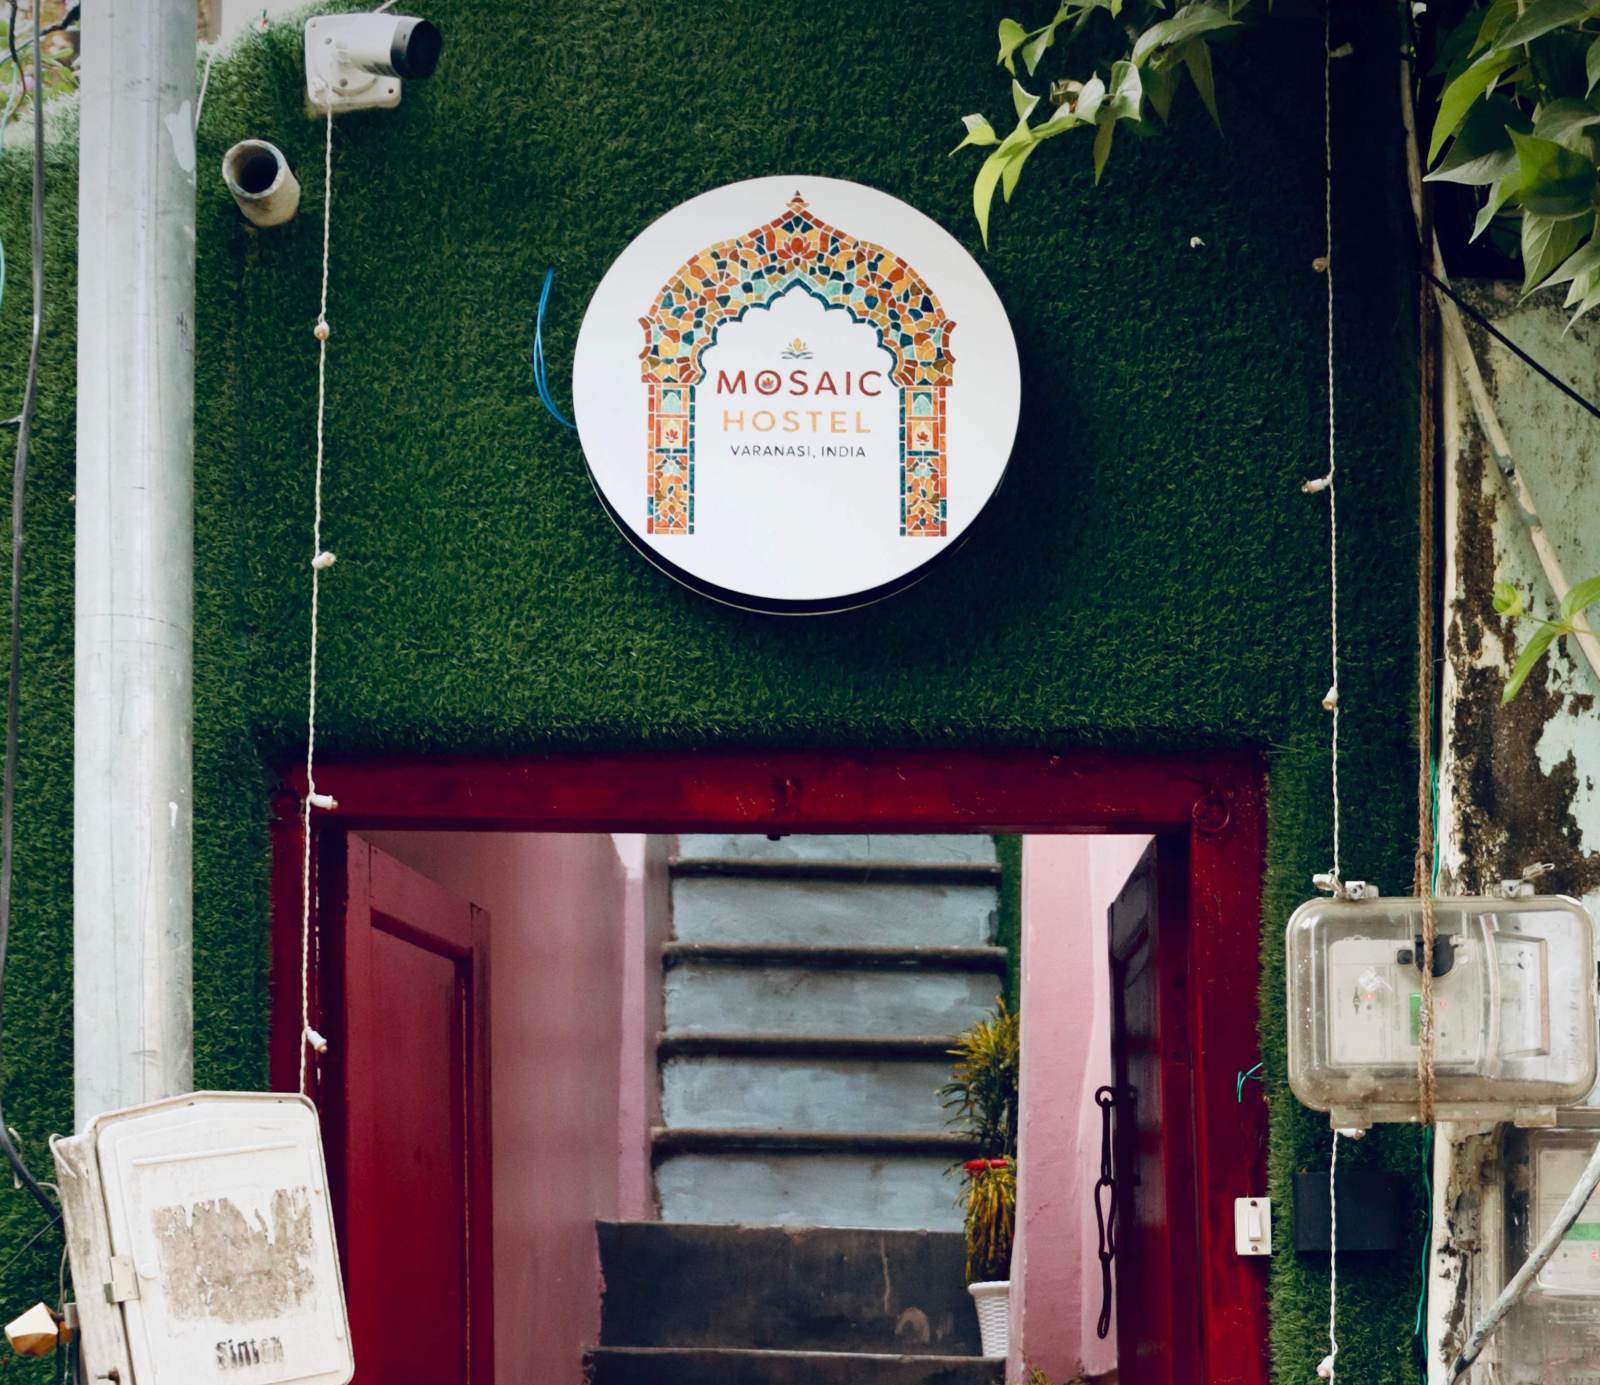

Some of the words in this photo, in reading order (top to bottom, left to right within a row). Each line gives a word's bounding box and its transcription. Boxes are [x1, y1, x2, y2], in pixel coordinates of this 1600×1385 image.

[716, 369, 882, 397] MOSAIC
[722, 410, 871, 433] HOSTEL
[730, 445, 816, 458] VARANASI,
[821, 446, 866, 457] INDIA
